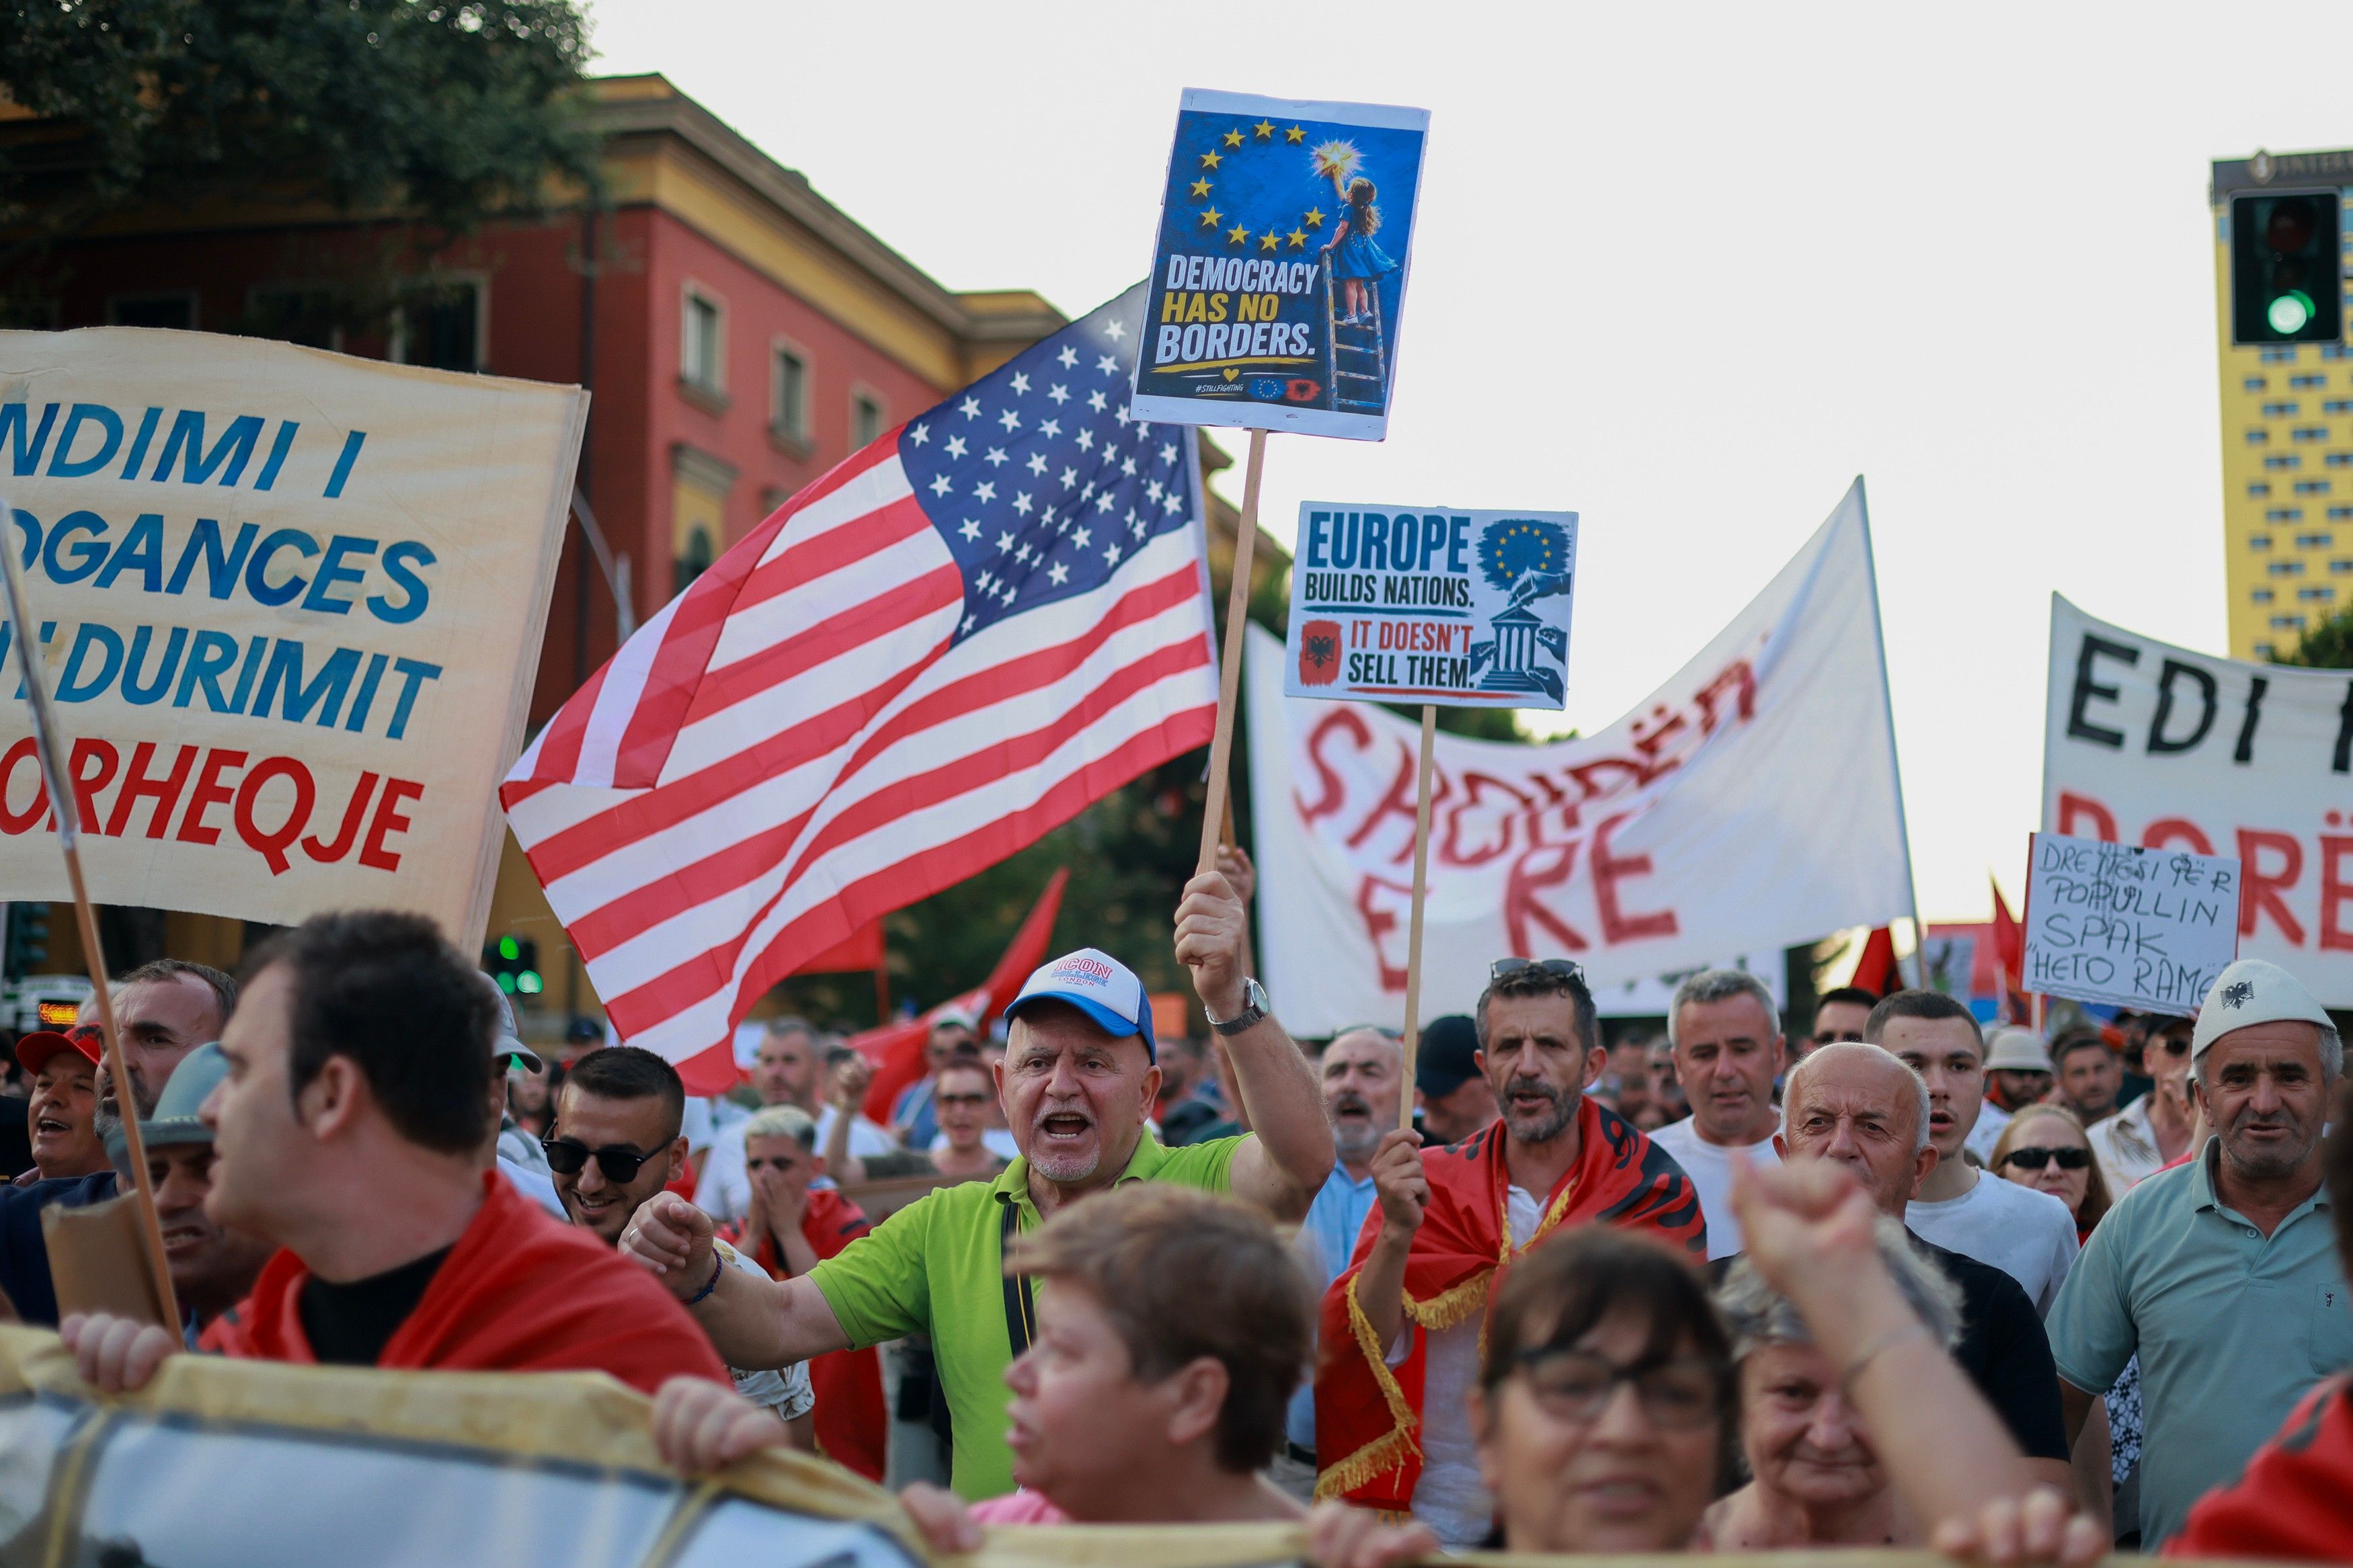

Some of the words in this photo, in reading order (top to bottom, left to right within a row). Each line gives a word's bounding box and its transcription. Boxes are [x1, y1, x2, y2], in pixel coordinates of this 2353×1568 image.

[1166, 254, 1319, 294] DEMOCRACY
[1161, 292, 1228, 323] HAS
[1237, 294, 1279, 322] NO
[1154, 323, 1315, 364] BORDERS.
[1195, 384, 1244, 393] #STILLFIGHTING
[323, 430, 366, 498] I
[1307, 511, 1472, 573] EUROPE
[1304, 573, 1377, 604] BUILDS
[1384, 574, 1475, 608] NATIONS.
[1351, 620, 1372, 649] IT
[1379, 622, 1474, 654] DOESN'T
[1348, 653, 1398, 686] SELL
[1406, 656, 1475, 689] THEM.
[2066, 632, 2269, 764] EDI
[1504, 809, 1681, 958] RE
[2042, 913, 2167, 956] SPAK
[1051, 971, 1108, 987] COLLEGE
[1054, 958, 1113, 979] ICON
[1058, 977, 1094, 986] LONDON
